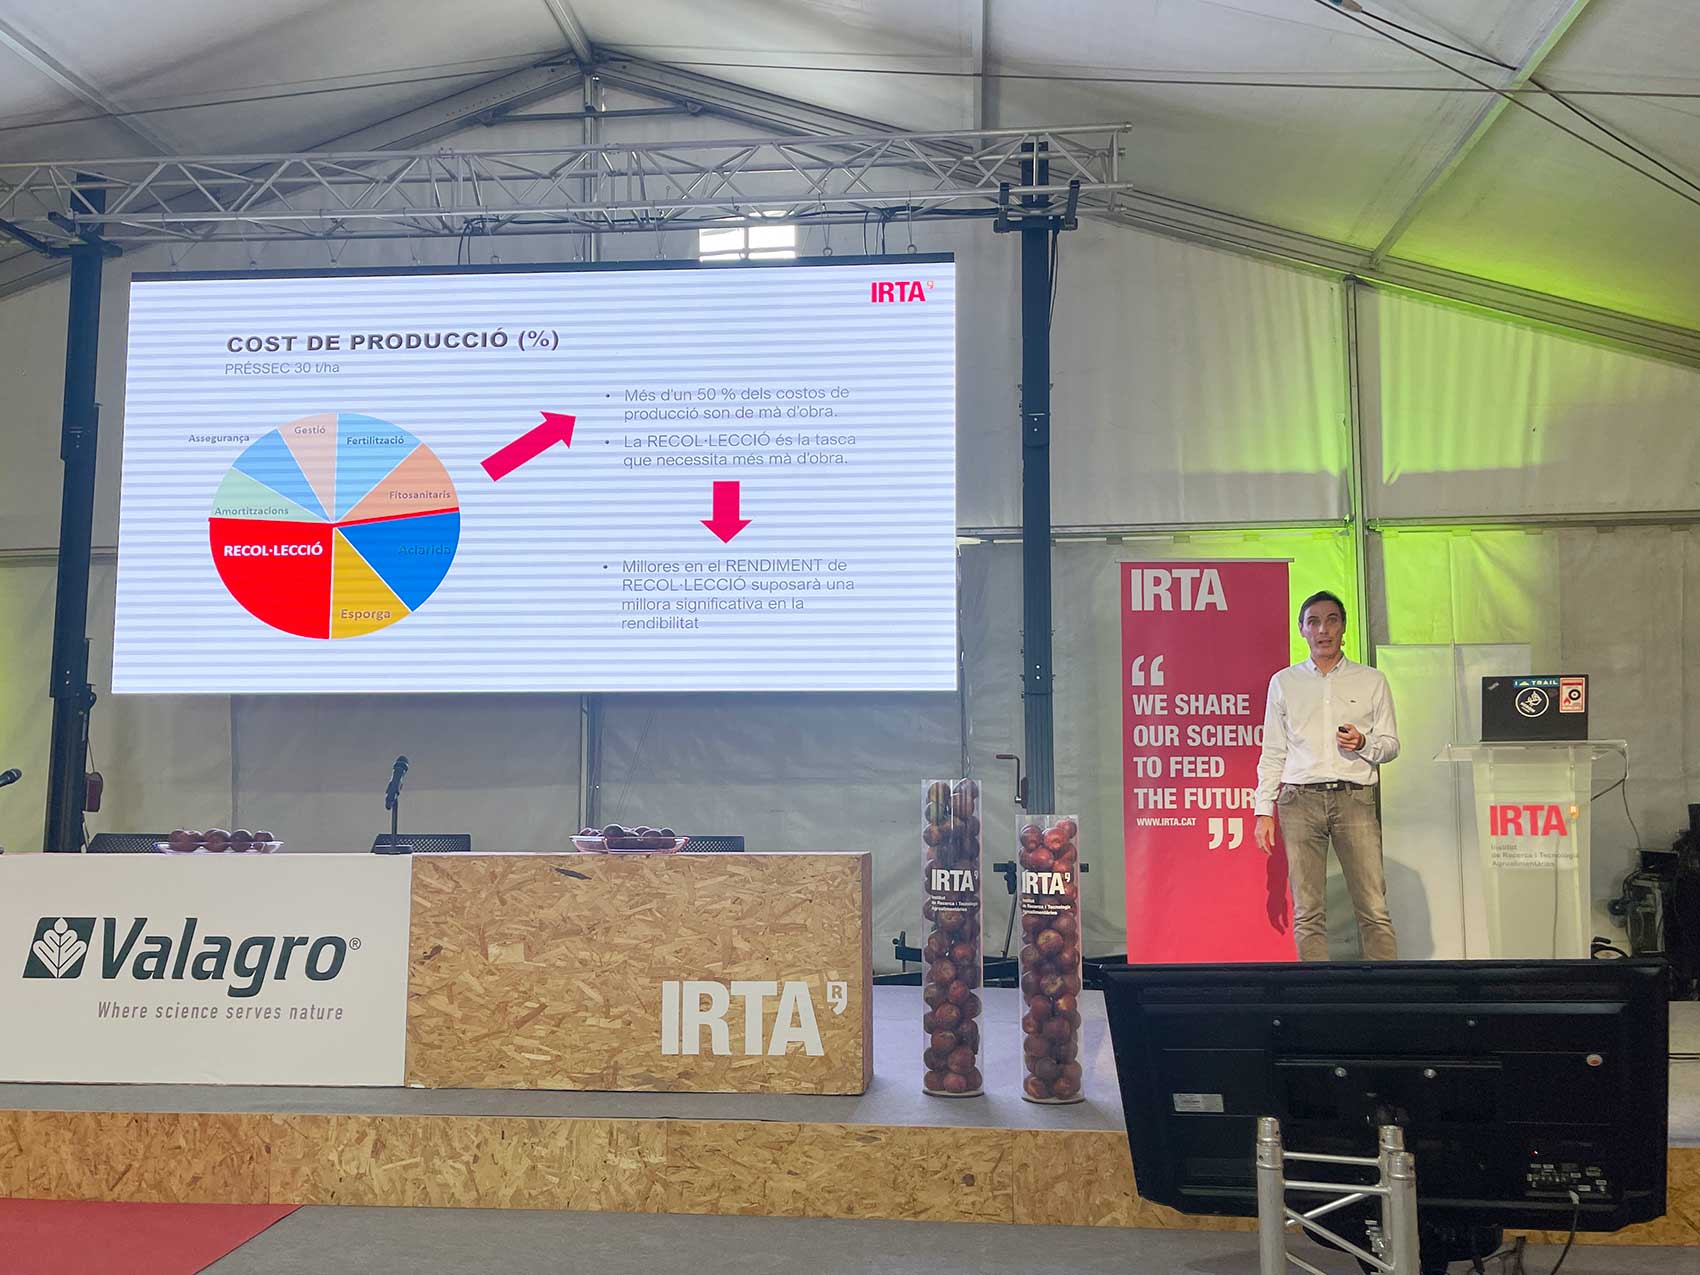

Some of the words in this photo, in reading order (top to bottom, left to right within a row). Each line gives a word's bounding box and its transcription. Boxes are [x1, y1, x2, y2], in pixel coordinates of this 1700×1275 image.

[872, 281, 926, 303] IRTA
[227, 335, 298, 353] COST
[306, 334, 341, 351] DE
[349, 328, 508, 351] PRODUCCIÓ
[518, 330, 560, 351] (%)
[225, 361, 290, 375] PRÉSSEC
[294, 362, 312, 374] 30
[315, 361, 340, 374] t/ha
[624, 389, 656, 401] Més
[661, 388, 692, 401] d'un
[697, 388, 716, 401] 50
[721, 388, 736, 400] %
[741, 387, 772, 400] dels
[776, 388, 826, 400] costos
[830, 386, 850, 399] de
[624, 407, 699, 423] producció
[703, 409, 730, 419] son
[735, 406, 754, 418] de
[759, 406, 782, 418] mà
[786, 405, 838, 418] d'obra.
[188, 434, 250, 443] Assegurança
[294, 425, 326, 435] Gestió
[346, 435, 405, 445] Fertilització
[624, 435, 642, 447] La
[647, 431, 771, 447] RECOL·LECCIÓ
[776, 433, 793, 446] és
[798, 433, 810, 445] la
[816, 433, 856, 445] tasca
[623, 456, 651, 469] que
[656, 453, 727, 466] necessita
[733, 453, 764, 464] més
[769, 453, 792, 464] mà
[797, 452, 848, 464] d'obra.
[389, 489, 451, 500] Fitosanitaris
[214, 506, 289, 515] Amortitzacions
[223, 541, 323, 557] RECOL·LECCIÓ
[622, 560, 680, 573] Millores
[685, 562, 703, 573] en
[708, 559, 721, 572] el
[726, 558, 823, 572] RENDIMENT
[827, 558, 848, 571] de
[622, 575, 746, 591] RECOL·LECCIÓ
[751, 577, 822, 593] suposarà
[826, 579, 855, 590] una
[1131, 568, 1228, 611] IRTA
[621, 597, 671, 611] millora
[676, 596, 763, 613] significativa
[768, 598, 787, 609] en
[792, 597, 804, 609] la
[340, 608, 391, 620] Esporga
[621, 616, 699, 629] rendibilitat
[1132, 694, 1168, 715] WE
[1175, 694, 1250, 715] SHARE
[1133, 725, 1180, 747] OUR
[1187, 725, 1264, 747] SCIENC
[1133, 756, 1163, 778] TO
[1170, 756, 1225, 778] FEED
[1134, 787, 1177, 809] THE
[1184, 787, 1256, 810] FUTUR
[1136, 818, 1197, 827] WWW.IRTA.CAT
[1489, 805, 1568, 836] IRTA
[931, 868, 975, 891] IRTA
[1022, 871, 1066, 895] IRTA
[98, 1001, 148, 1019] Where
[155, 1001, 218, 1019] science
[225, 1005, 282, 1020] serves
[288, 1003, 344, 1020] nature
[661, 980, 825, 1056] IRTA
